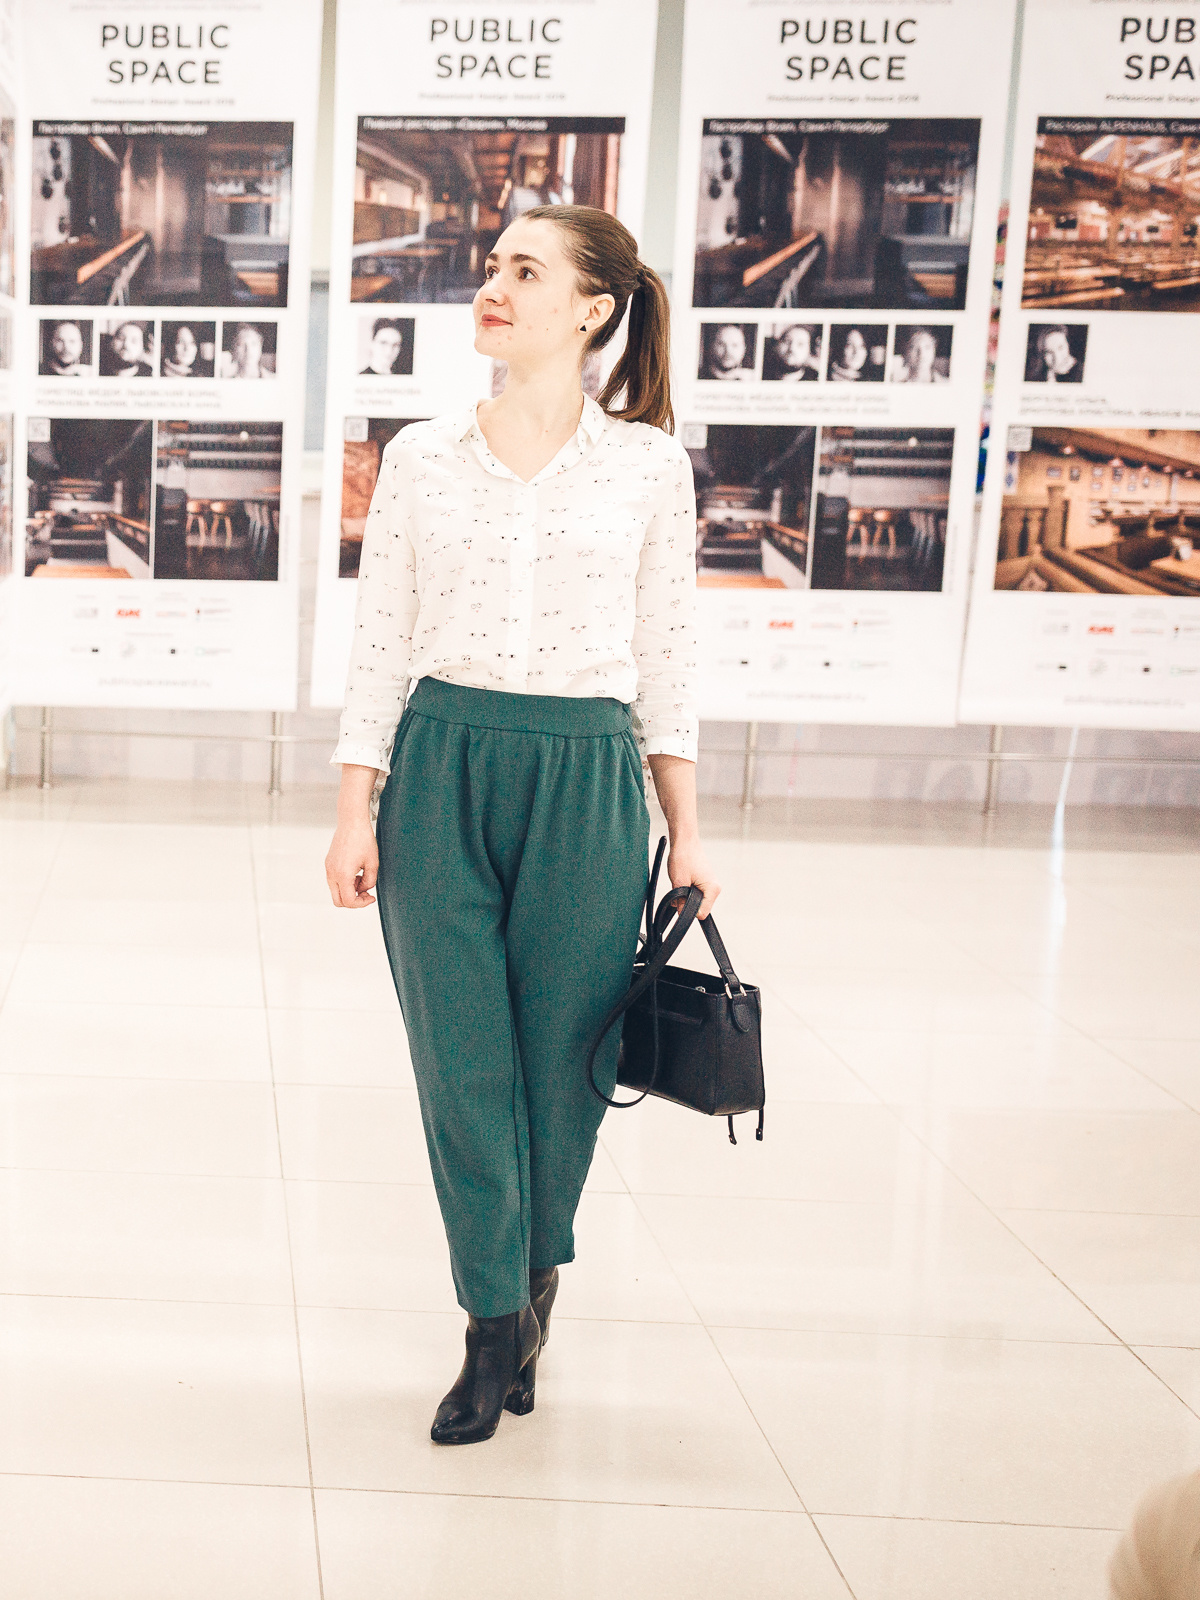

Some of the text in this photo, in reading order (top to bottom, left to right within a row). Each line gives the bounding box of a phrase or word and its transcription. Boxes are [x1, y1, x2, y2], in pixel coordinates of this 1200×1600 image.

[102, 25, 230, 49] PUBLIC
[430, 18, 562, 43] PUBLIC
[780, 19, 918, 44] PUBLIC
[1119, 18, 1197, 43] PUB
[108, 61, 220, 84] SPACE
[436, 55, 552, 79] SPACE
[785, 56, 907, 81] SPACE
[1124, 55, 1200, 80] SPA
